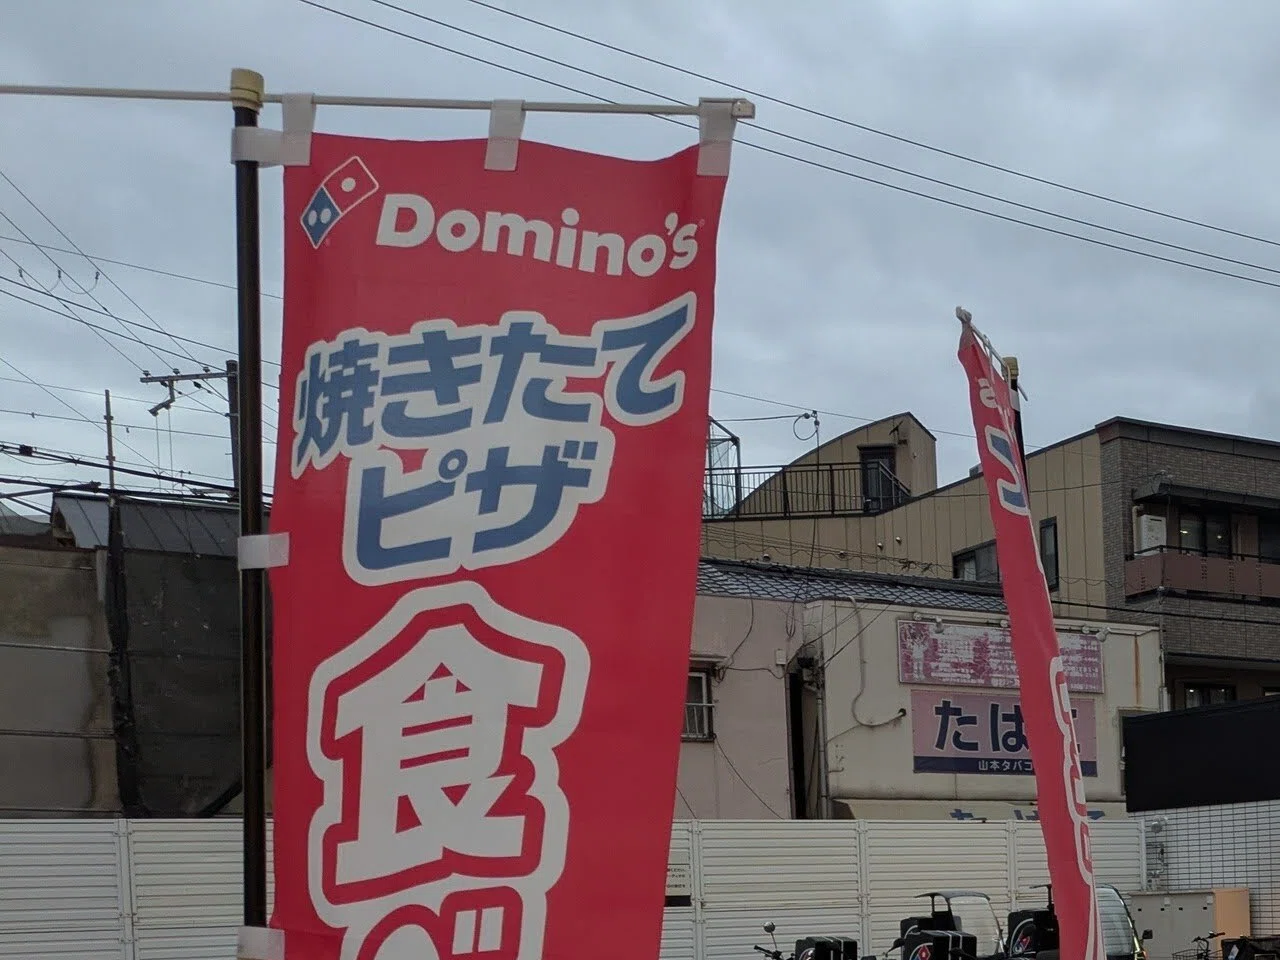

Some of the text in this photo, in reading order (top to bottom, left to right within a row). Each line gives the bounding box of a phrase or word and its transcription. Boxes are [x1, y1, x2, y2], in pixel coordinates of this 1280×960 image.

[375, 192, 698, 278] Domino's
[294, 298, 693, 470] 焼きたて
[354, 438, 600, 573] ピザ
